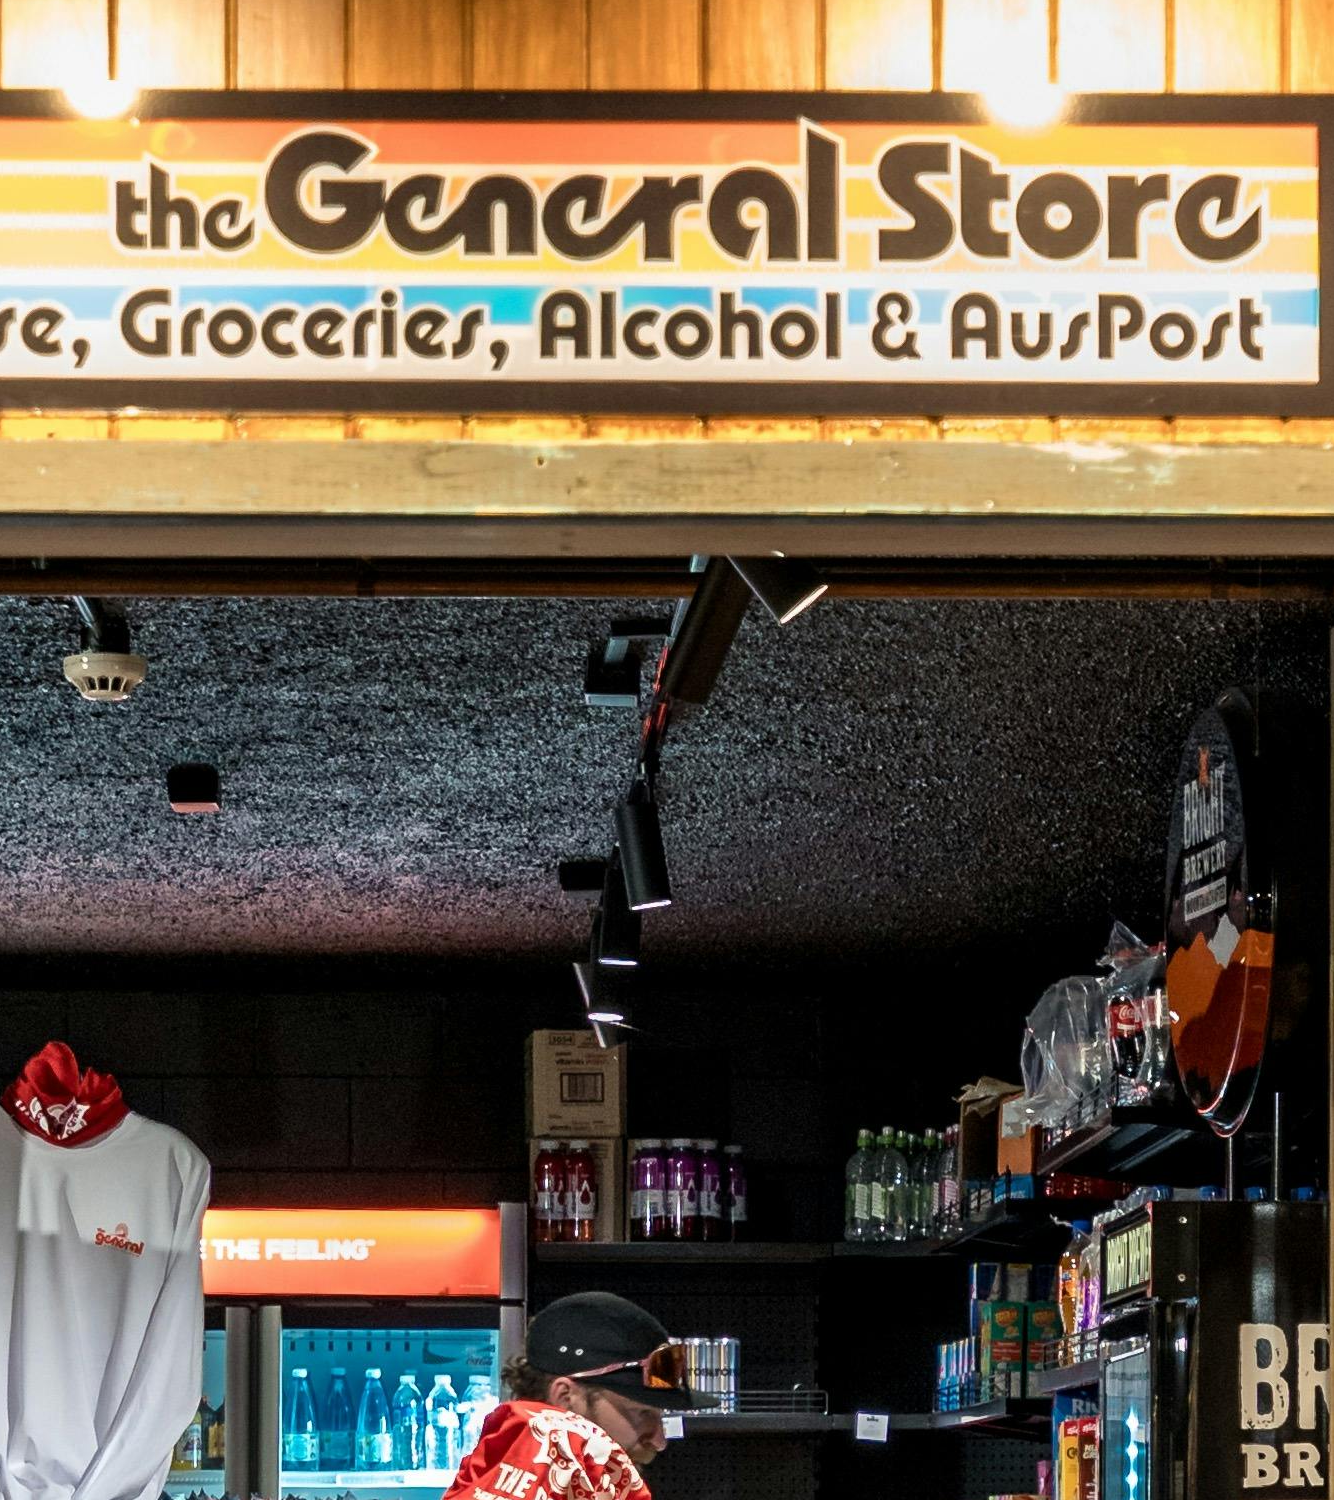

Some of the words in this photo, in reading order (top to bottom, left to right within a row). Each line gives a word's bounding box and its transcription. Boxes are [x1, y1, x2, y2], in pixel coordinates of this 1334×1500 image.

[114, 162, 254, 250] the
[264, 127, 840, 263] General
[877, 141, 1263, 263] Store
[118, 288, 510, 371] Groceries,
[540, 290, 841, 360] Alcohol
[871, 291, 920, 360] &
[951, 291, 1263, 360] AusPost
[1183, 839, 1227, 886] BREWERY
[210, 1238, 261, 1261] THE
[493, 1462, 537, 1499] THE
